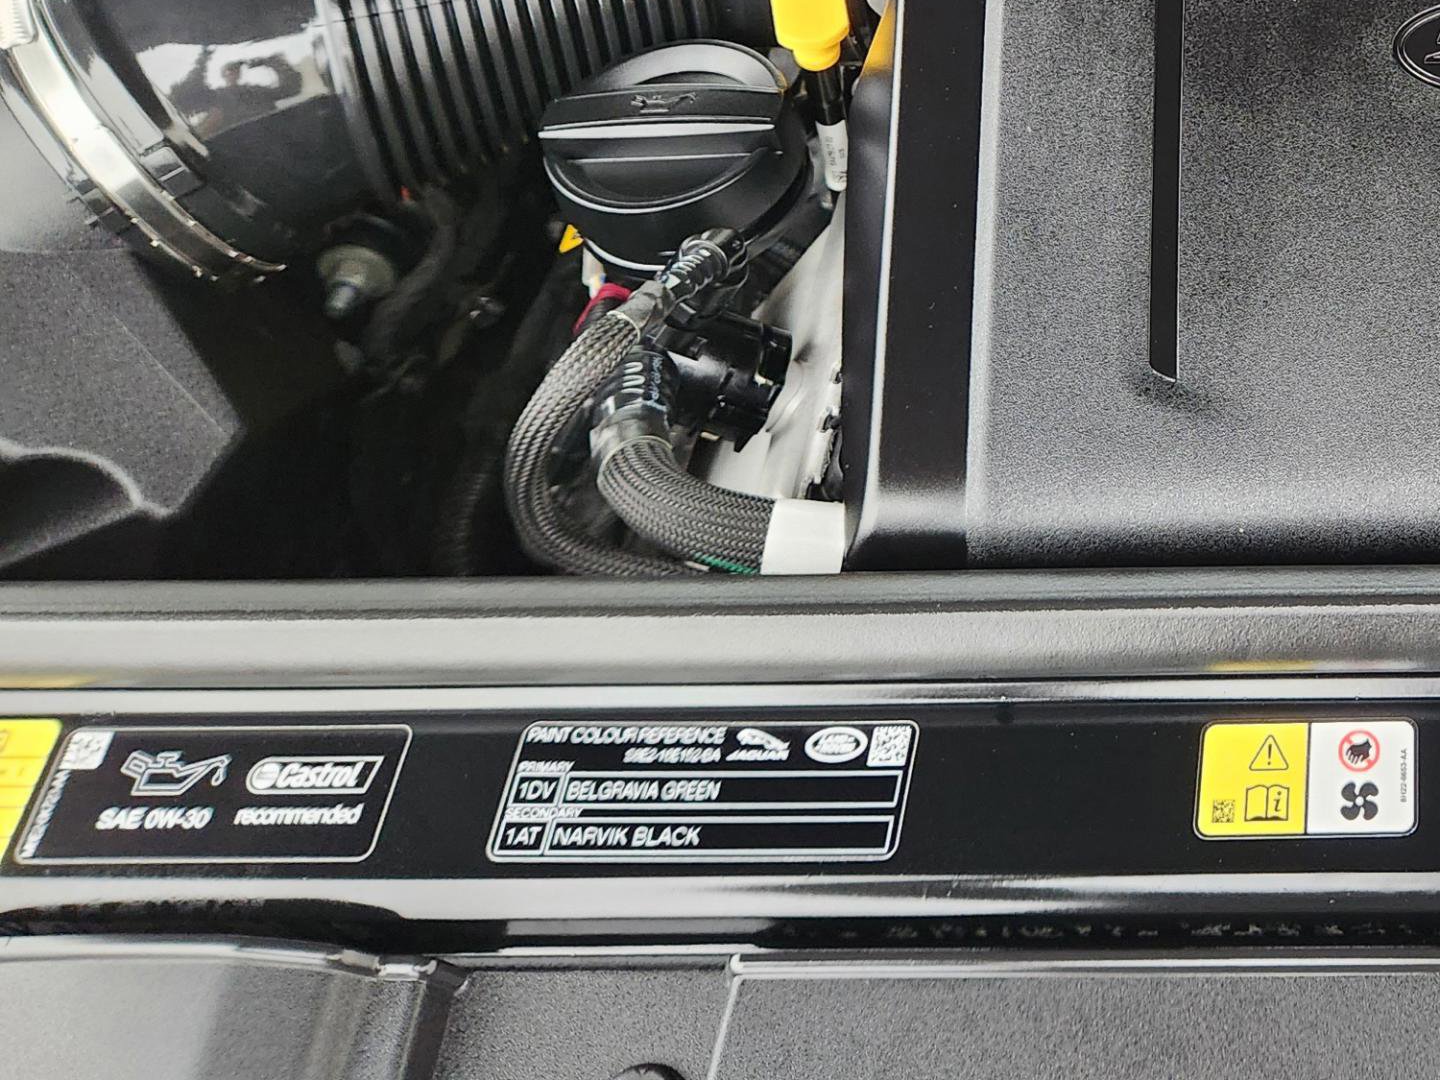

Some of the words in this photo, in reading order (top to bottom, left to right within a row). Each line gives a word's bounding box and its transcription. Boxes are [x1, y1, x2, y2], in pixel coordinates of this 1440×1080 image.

[526, 727, 574, 744] PAINT
[570, 727, 637, 744] COLOUR
[635, 727, 728, 744] REFERENCE
[278, 761, 364, 788] Castrol
[518, 780, 557, 800] 1DV
[566, 779, 659, 801] BELGRAVIA
[660, 779, 721, 801] GREEN
[96, 807, 144, 829] SAE
[142, 807, 215, 829] 0W-30
[233, 803, 364, 825] recommended
[505, 807, 584, 818] SECONDARY
[505, 826, 543, 846] 1AT
[551, 825, 630, 846] NARVIK
[631, 825, 702, 847] BLACK
